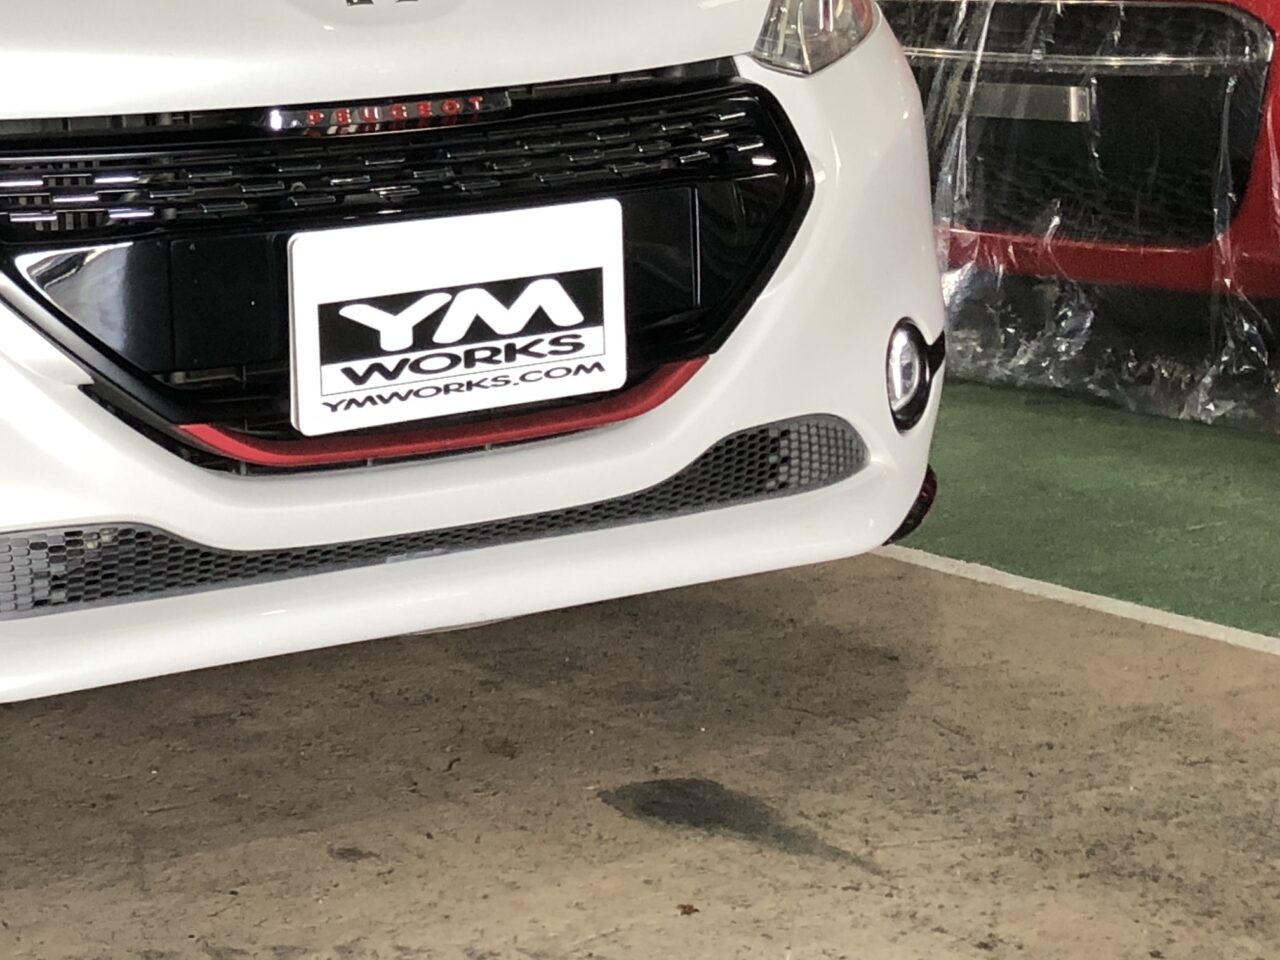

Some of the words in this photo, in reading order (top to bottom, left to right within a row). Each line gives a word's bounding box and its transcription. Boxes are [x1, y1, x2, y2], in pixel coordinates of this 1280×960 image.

[307, 95, 484, 126] PEUGEOT
[339, 278, 585, 352] YM
[340, 334, 586, 386] WORKS
[322, 362, 606, 413] YMWORKS.COM
